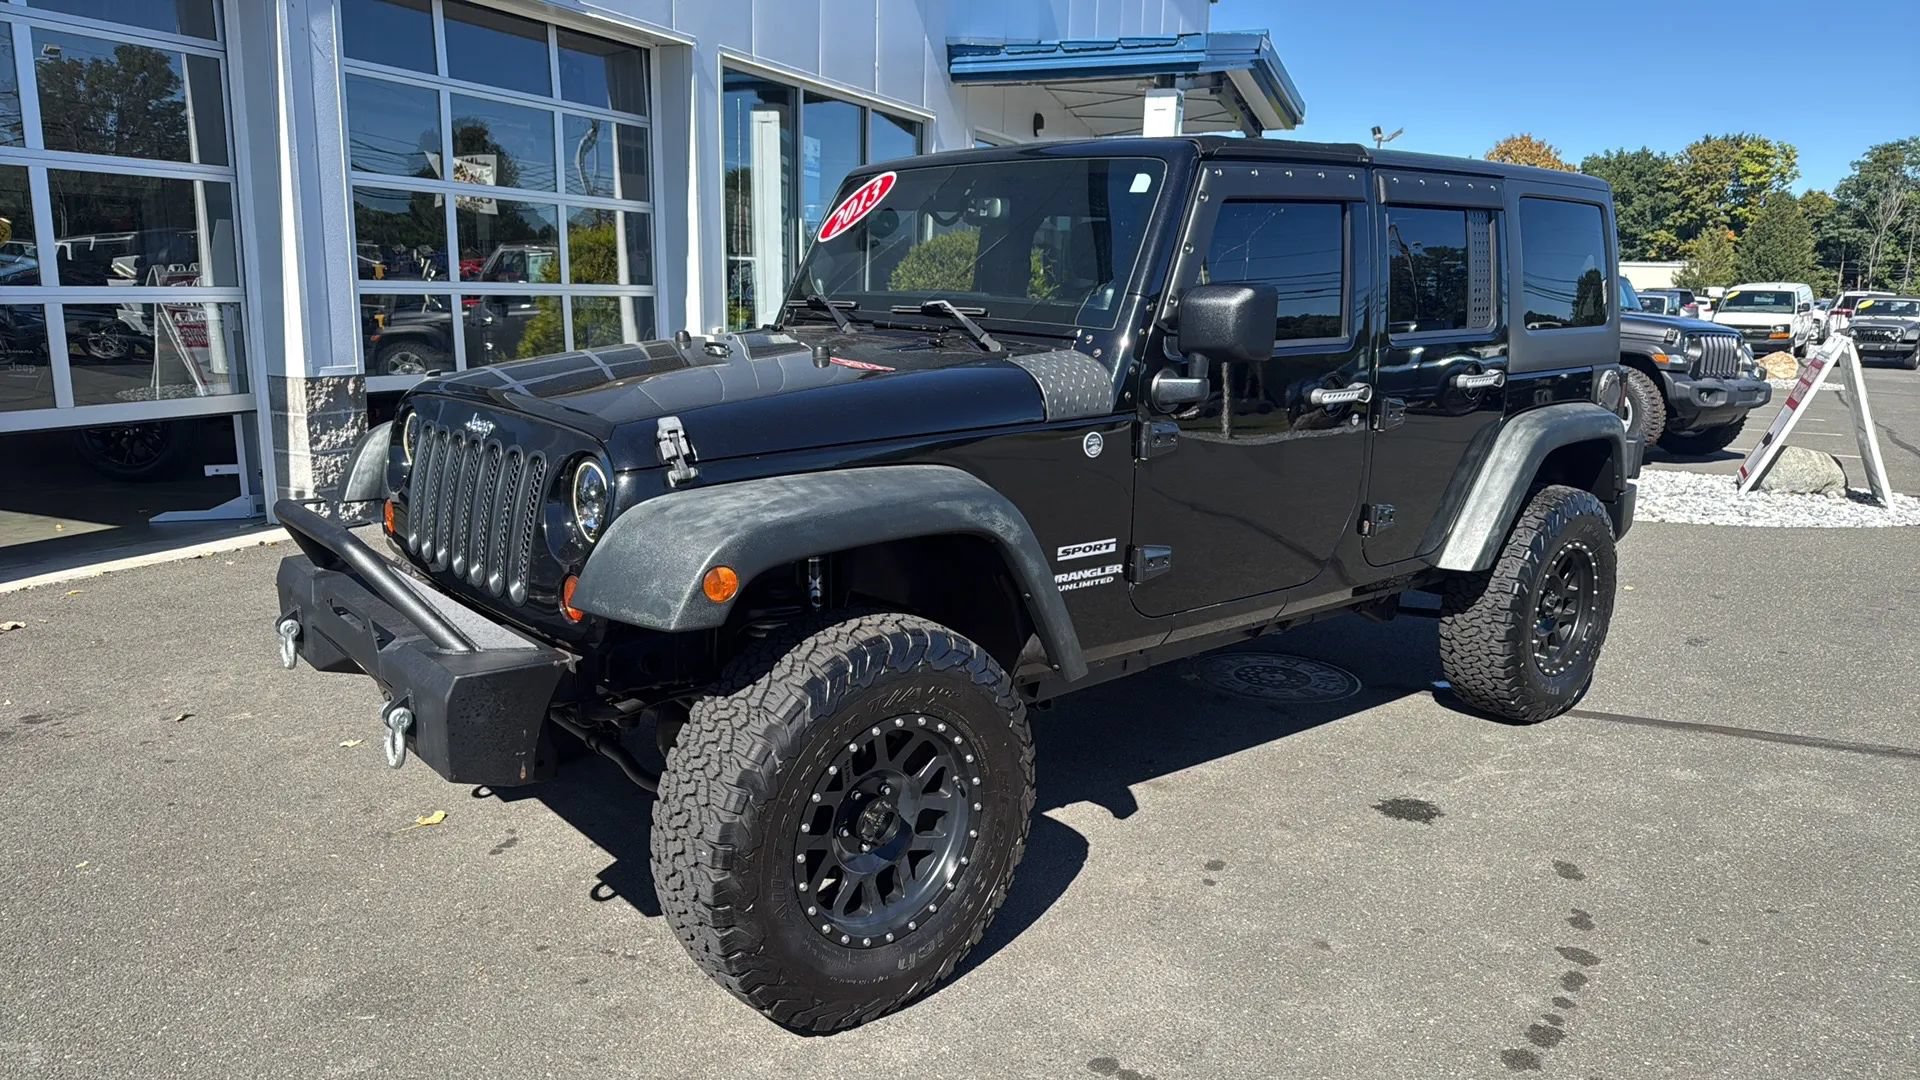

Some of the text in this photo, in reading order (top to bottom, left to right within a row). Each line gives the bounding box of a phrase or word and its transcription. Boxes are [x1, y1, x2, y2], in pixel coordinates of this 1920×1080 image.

[829, 179, 882, 236] 2013
[1060, 541, 1114, 558] SPORT
[1058, 576, 1114, 591] UNLIMITED
